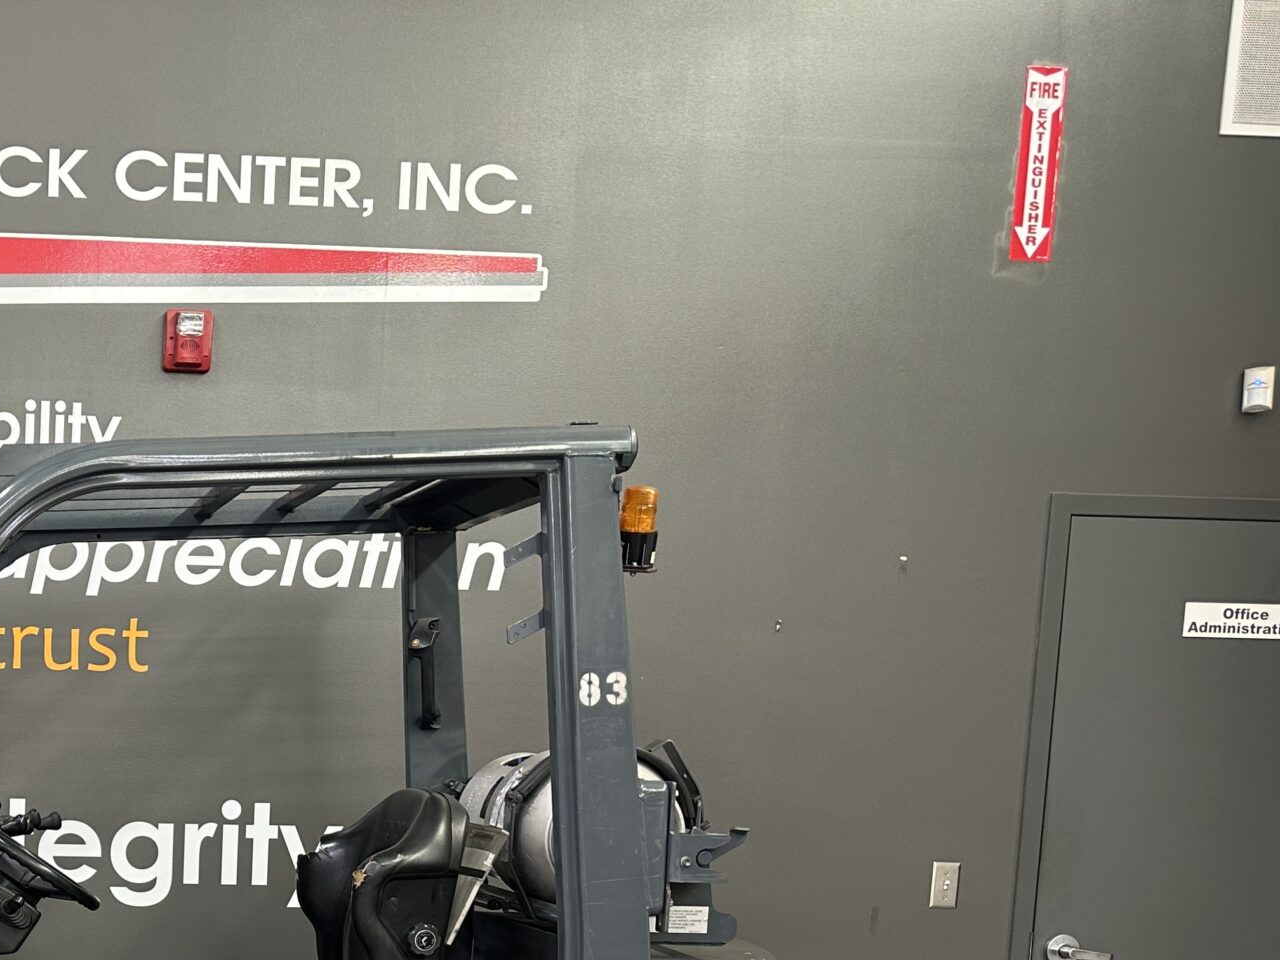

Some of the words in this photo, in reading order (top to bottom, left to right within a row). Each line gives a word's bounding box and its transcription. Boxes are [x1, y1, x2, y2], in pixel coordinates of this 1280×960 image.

[1029, 82, 1061, 100] FIRE
[115, 150, 375, 218] CENTER,
[398, 161, 533, 215] INC.
[1025, 108, 1048, 246] EXTINGUISHER
[1223, 607, 1269, 621] Office
[579, 671, 628, 707] 83
